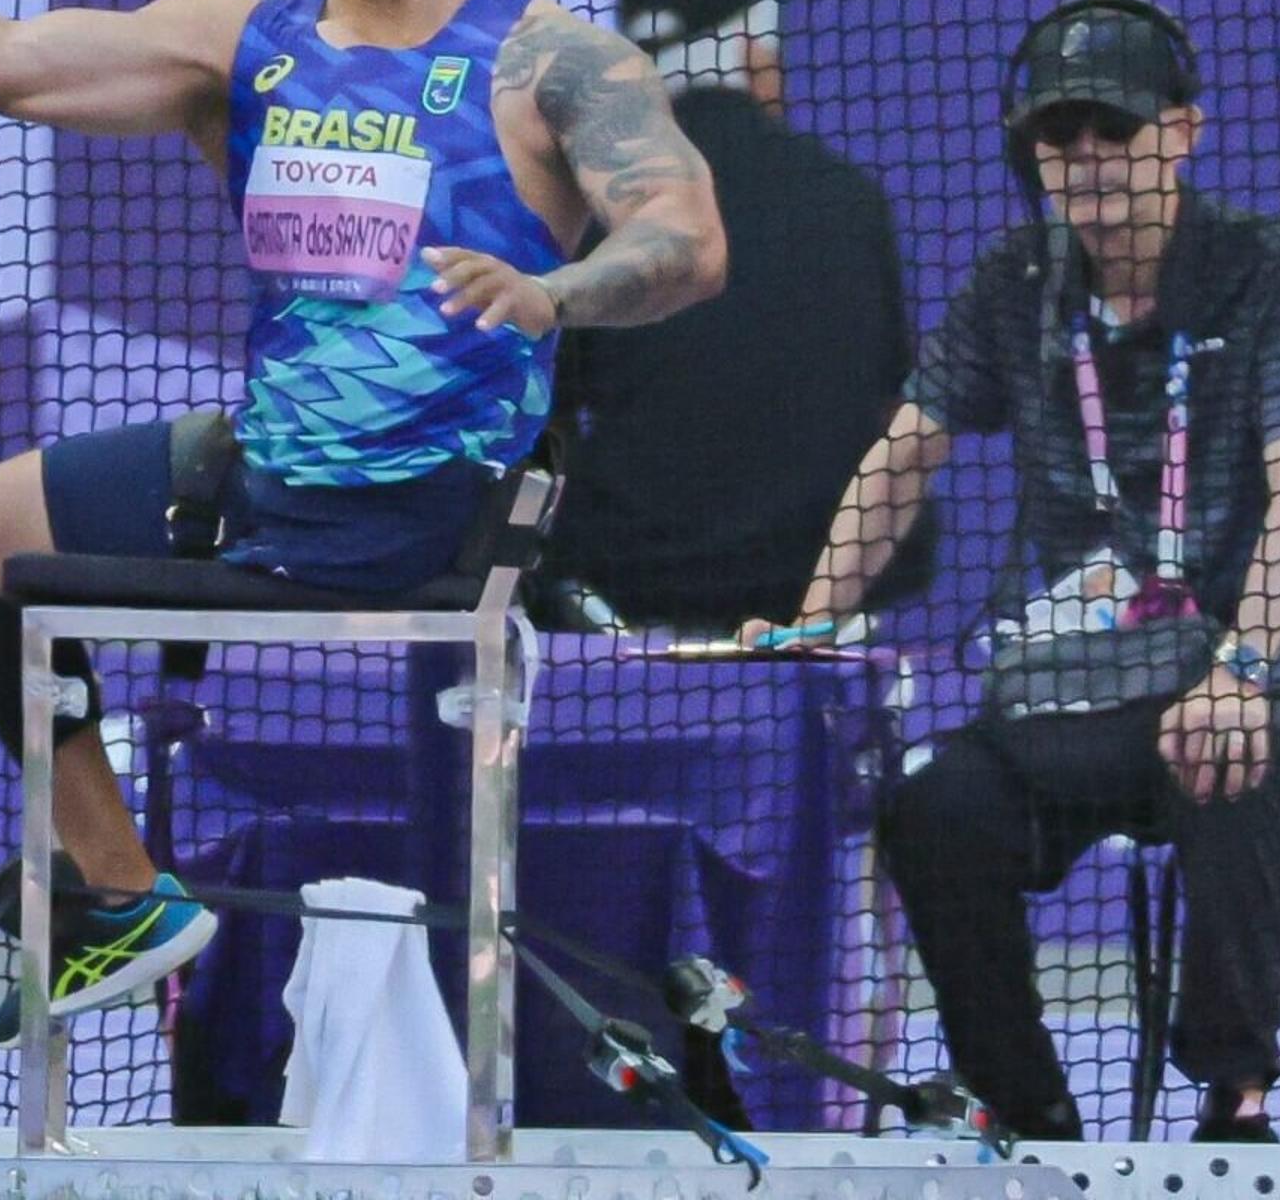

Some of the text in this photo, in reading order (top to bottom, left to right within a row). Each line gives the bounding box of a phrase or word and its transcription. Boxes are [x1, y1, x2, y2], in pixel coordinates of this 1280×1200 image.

[262, 105, 426, 158] BRASIL
[272, 160, 377, 187] TOYOTA
[306, 212, 332, 256] dos
[334, 213, 410, 265] SANTOS
